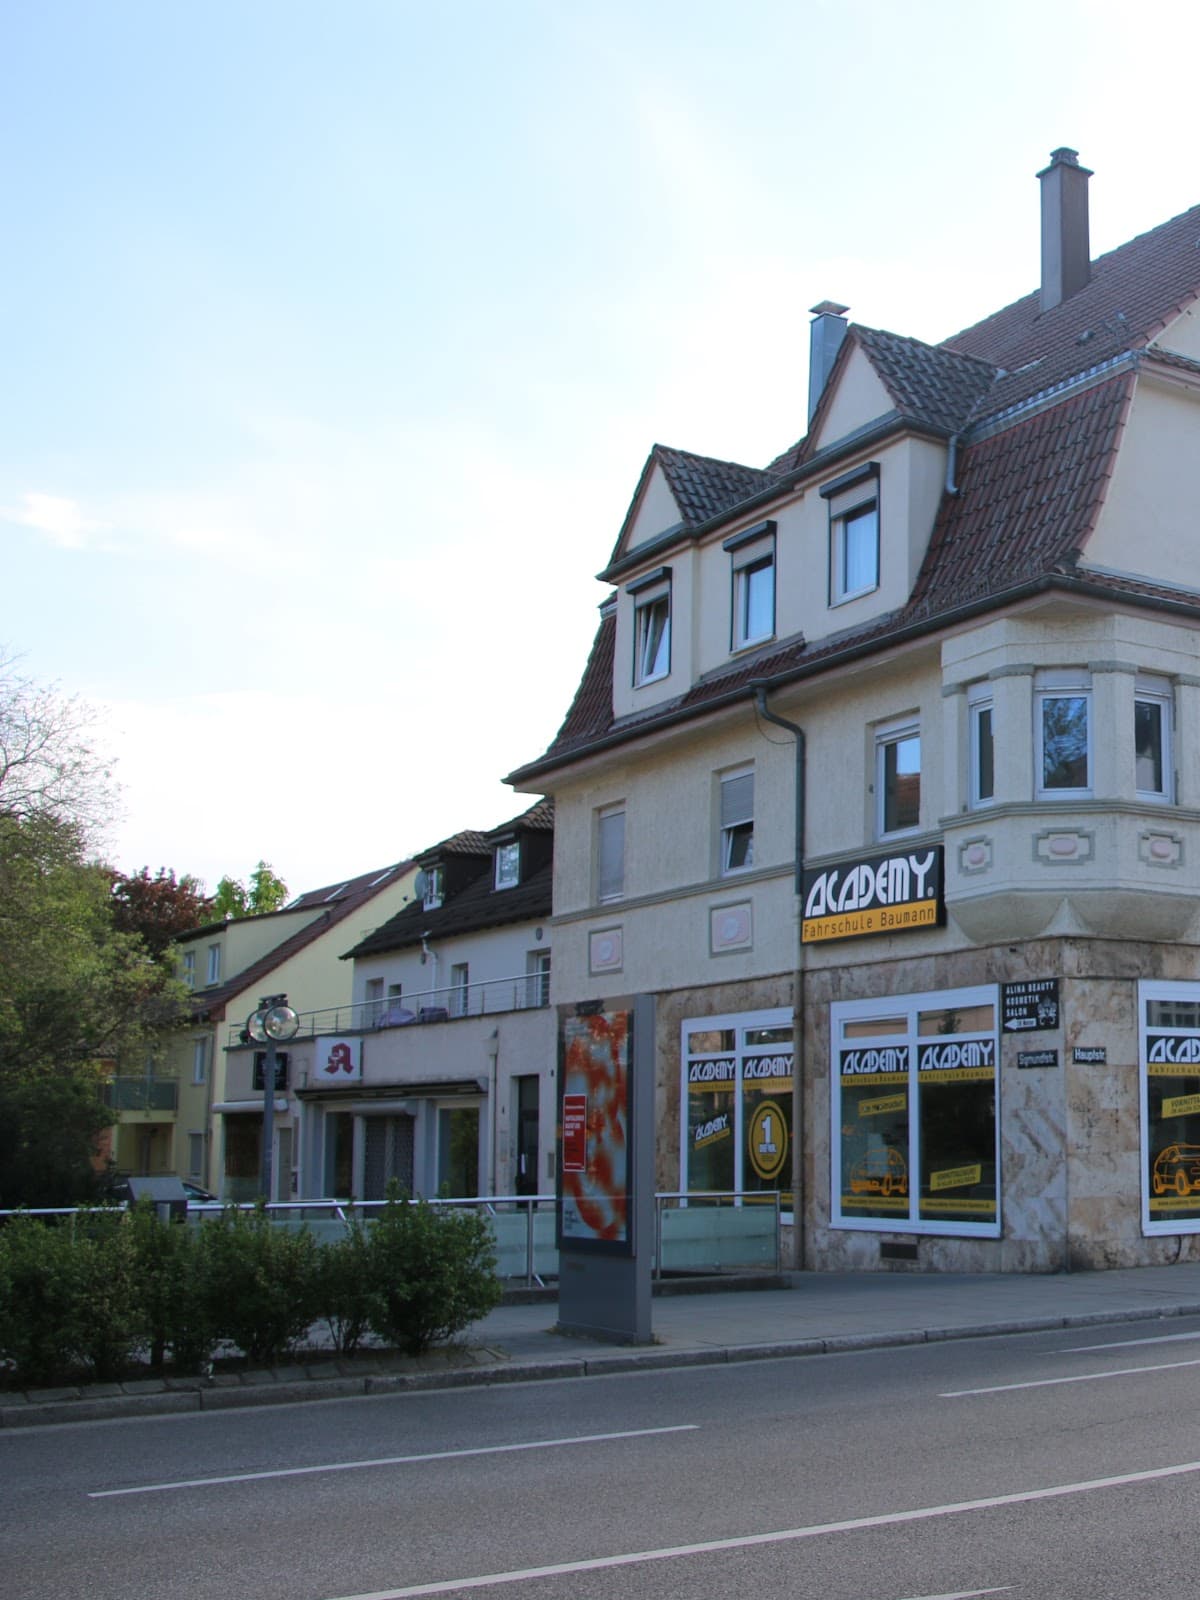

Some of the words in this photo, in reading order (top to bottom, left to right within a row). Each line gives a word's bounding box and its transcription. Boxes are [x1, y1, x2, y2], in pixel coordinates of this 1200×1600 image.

[804, 917, 873, 938] Fahrschule
[881, 907, 934, 927] Baumann
[1006, 985, 1026, 994] ALINA
[1028, 982, 1054, 992] BEAUTY
[1006, 995, 1040, 1006] KOSMETIK
[1006, 1008, 1027, 1017] SALON
